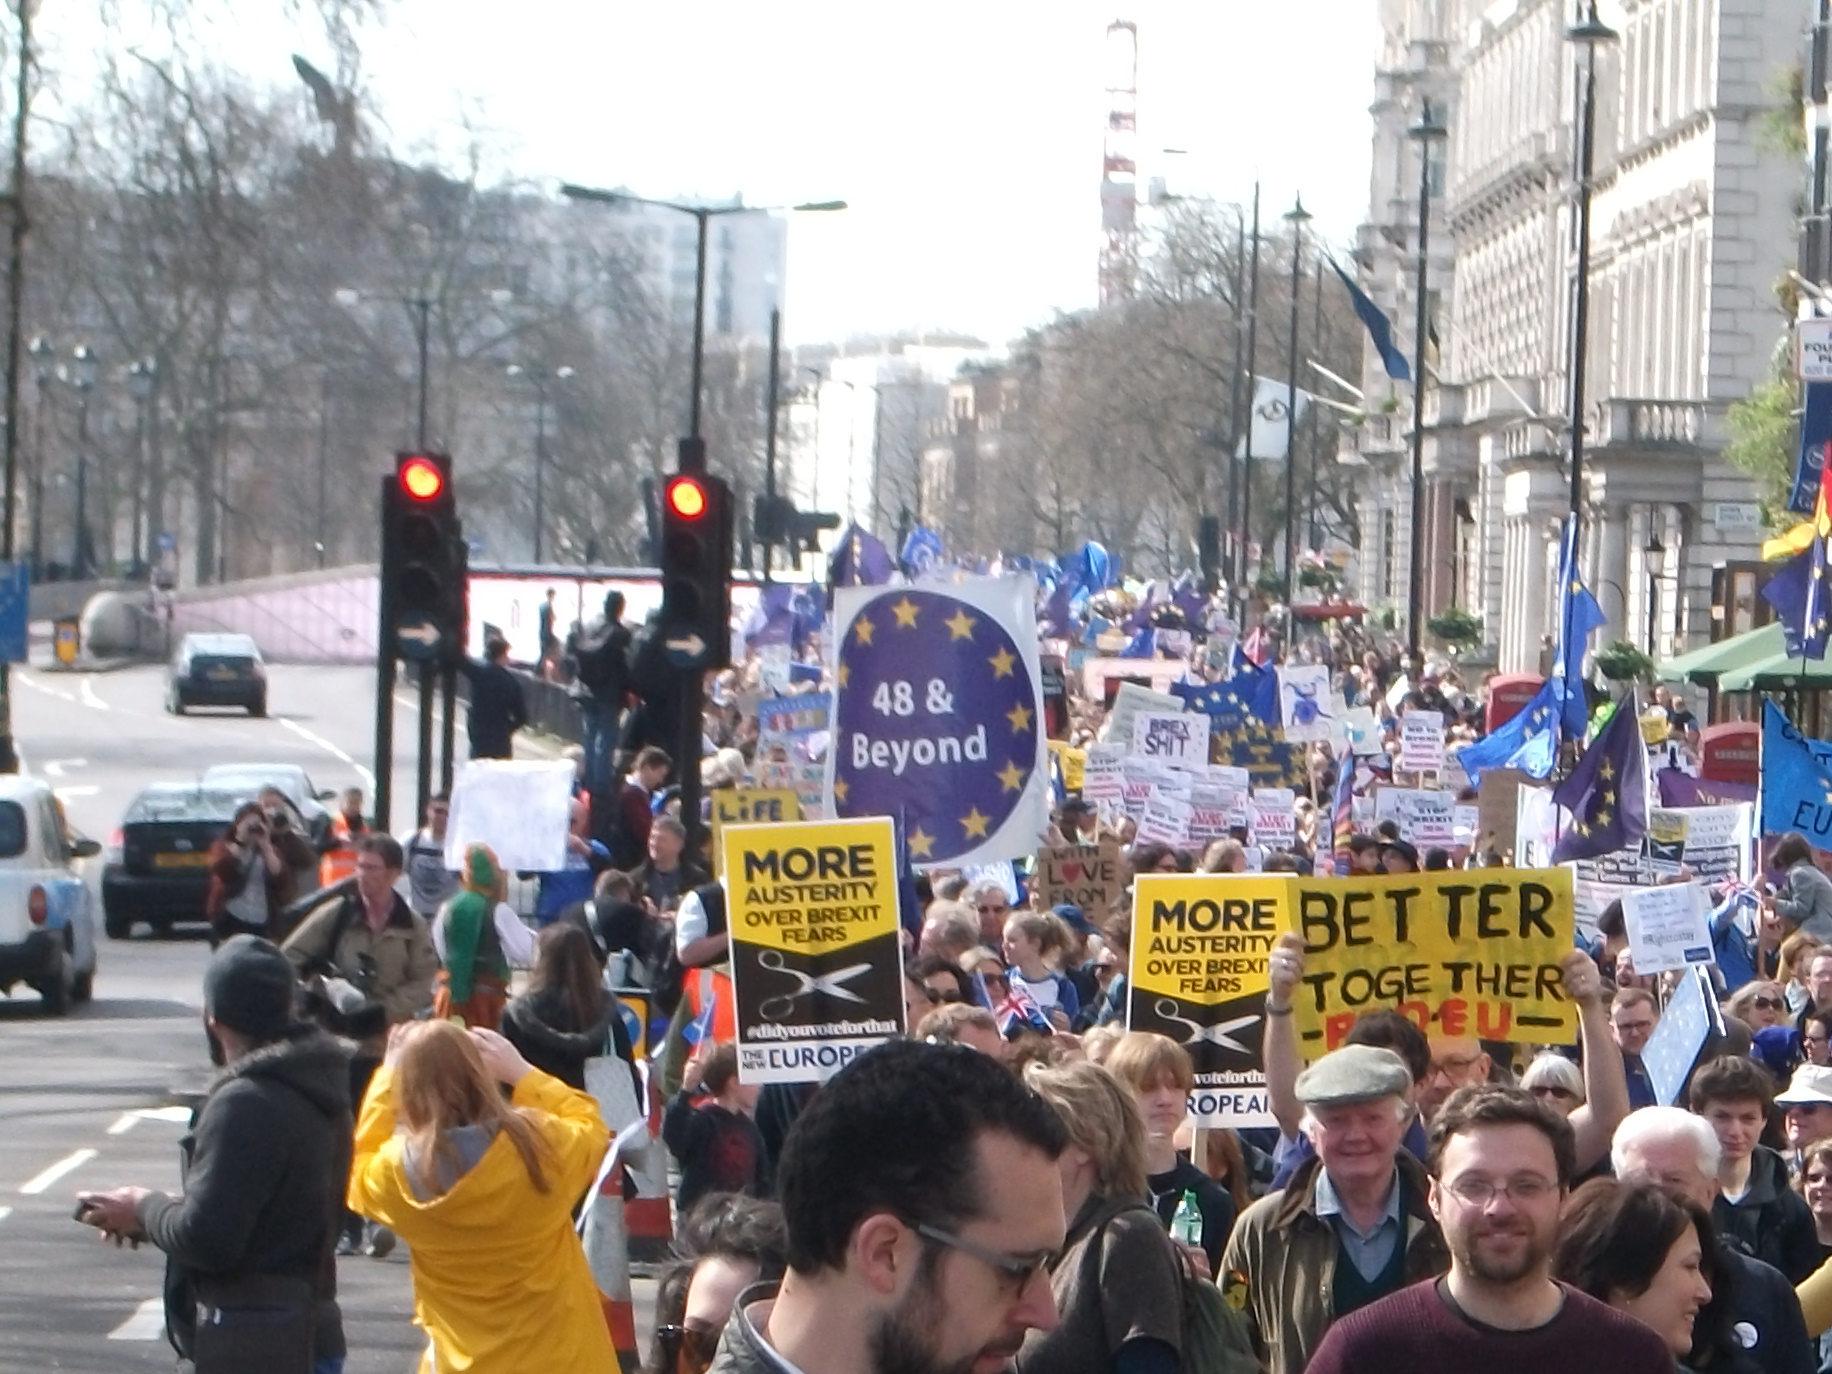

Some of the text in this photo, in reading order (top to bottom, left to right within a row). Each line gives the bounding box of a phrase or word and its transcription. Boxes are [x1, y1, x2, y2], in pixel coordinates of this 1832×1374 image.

[872, 677, 955, 717] 48 &
[852, 723, 988, 777] Beyond
[1145, 734, 1186, 756] SHIT
[744, 844, 877, 882] MORE
[745, 881, 877, 905] AUSTERITY
[1049, 888, 1106, 905] FROM
[745, 905, 881, 927] OVER BREXIT
[1152, 898, 1278, 932] MORE
[1300, 883, 1556, 954] BETTER
[781, 926, 847, 943] FEARS
[1149, 935, 1276, 954] AUSTERITY
[1147, 959, 1202, 976] OVER
[1179, 977, 1242, 993] FEARS
[1303, 962, 1566, 1013] TOGETHER
[742, 1060, 766, 1070] NEW
